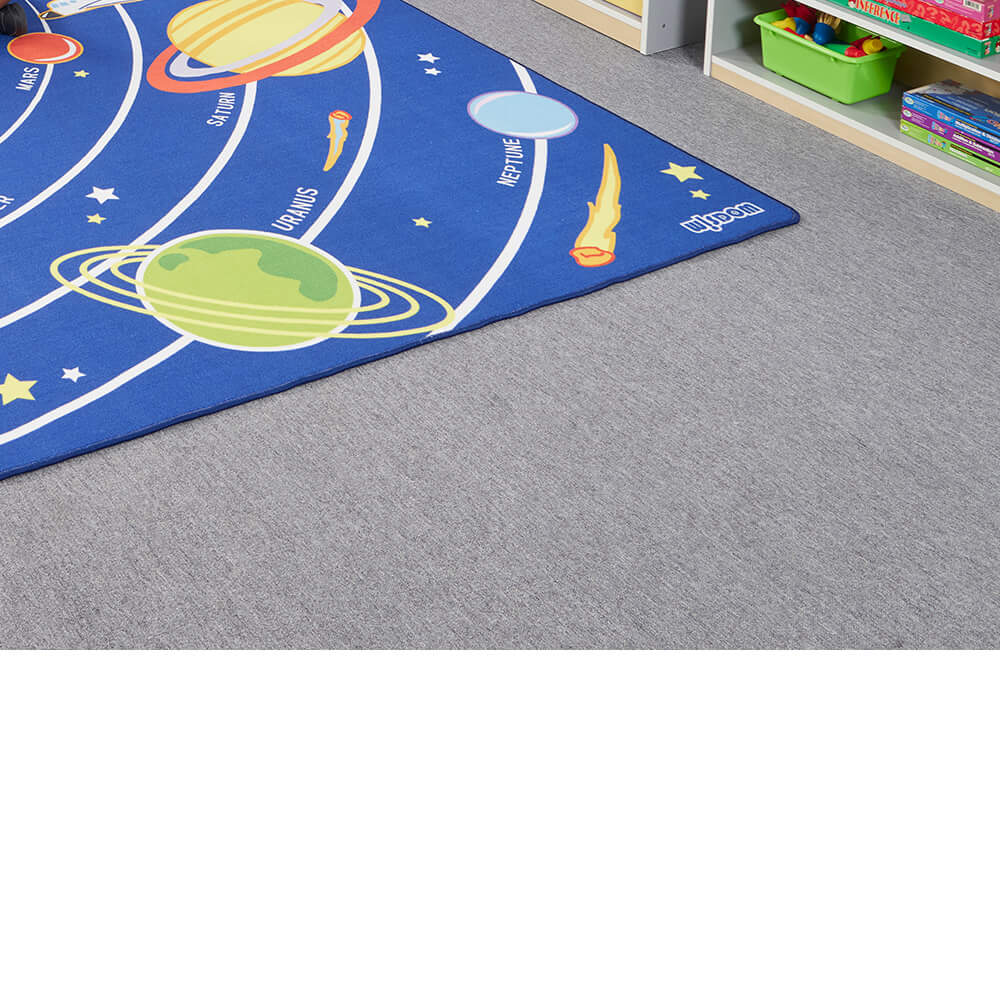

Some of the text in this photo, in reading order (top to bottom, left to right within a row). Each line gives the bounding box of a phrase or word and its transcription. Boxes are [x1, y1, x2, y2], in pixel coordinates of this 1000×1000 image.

[15, 66, 40, 92] MARS
[206, 91, 236, 128] SATURN
[496, 138, 523, 187] NEPTUNE
[270, 186, 319, 232] URANUS
